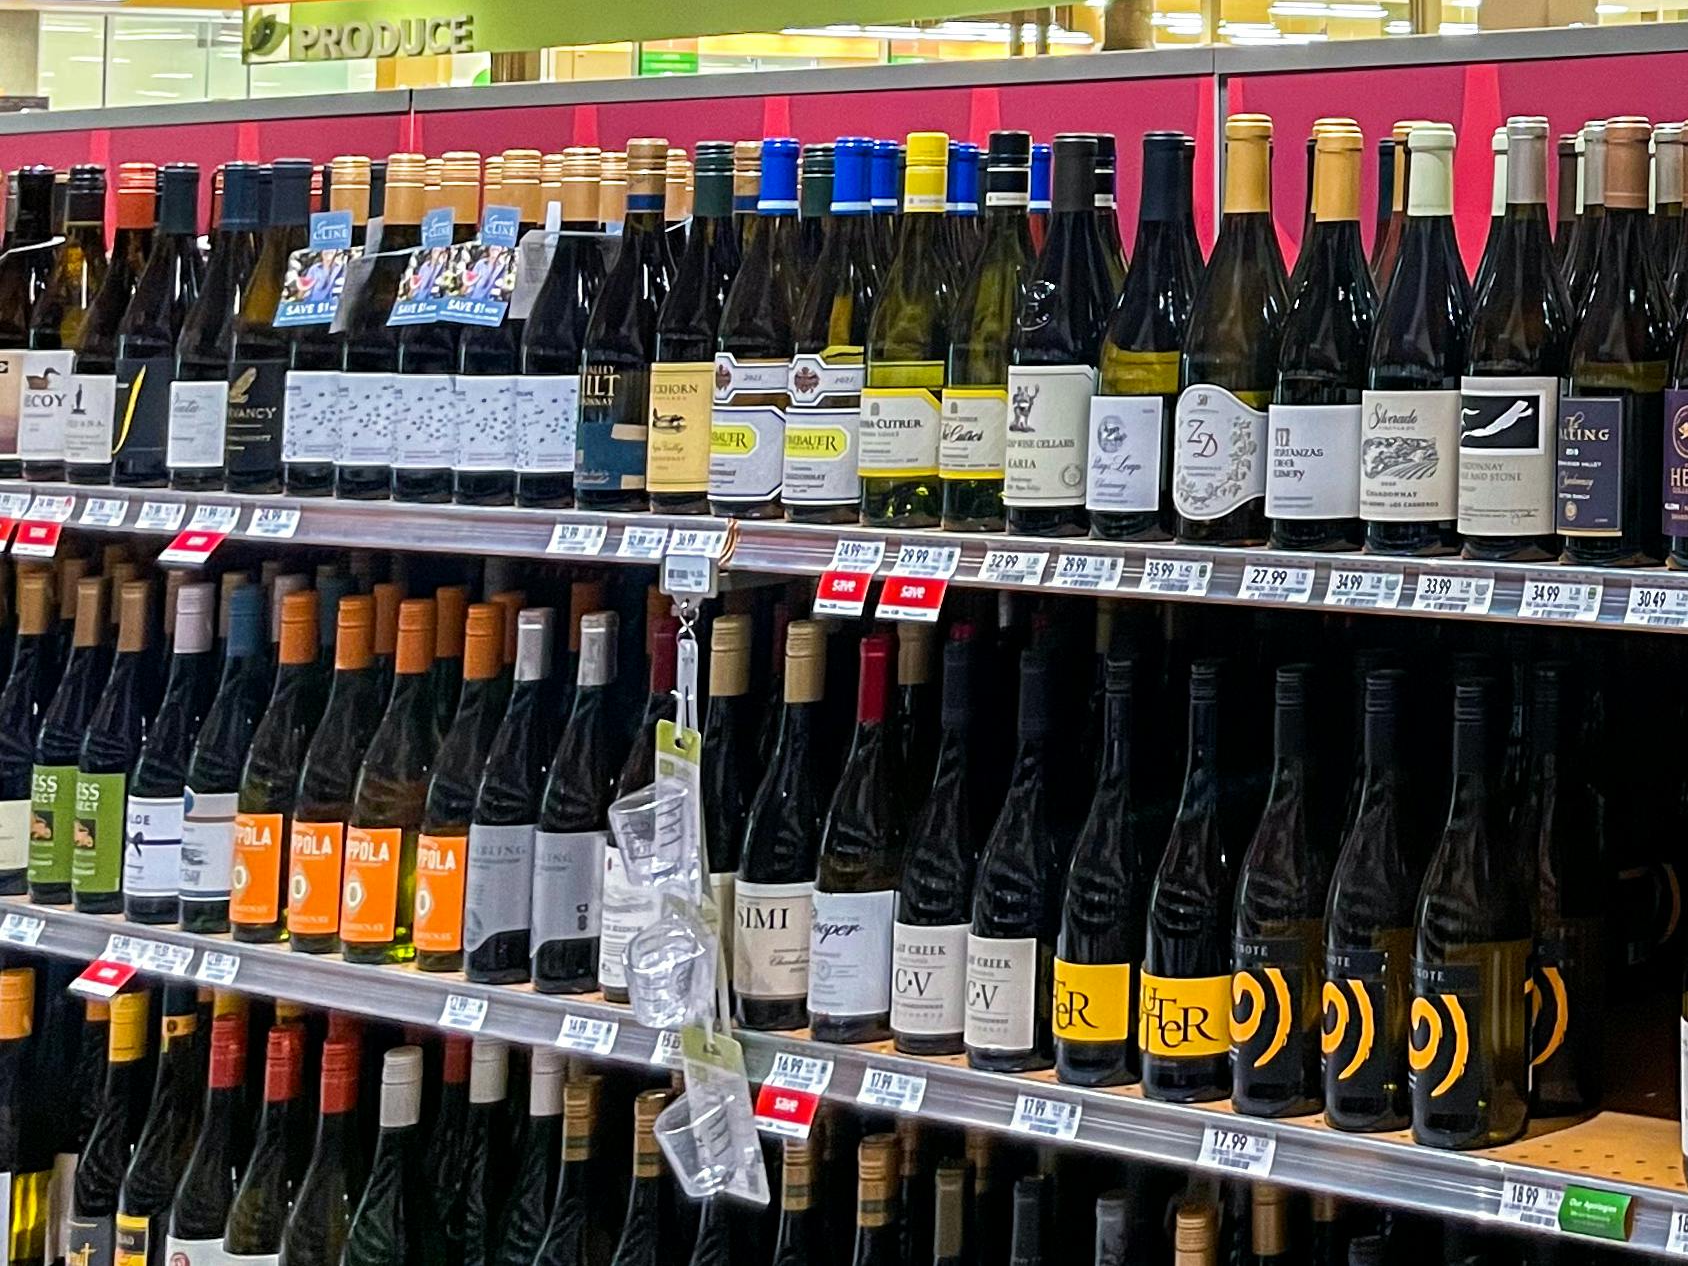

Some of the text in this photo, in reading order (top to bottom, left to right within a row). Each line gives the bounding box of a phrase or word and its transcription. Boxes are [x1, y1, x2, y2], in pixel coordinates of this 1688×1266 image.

[296, 14, 474, 59] PRODUCE
[286, 302, 330, 316] SAVE $1
[399, 302, 416, 315] SAVE
[447, 299, 485, 315] SAVE $1
[24, 393, 67, 408] ECOY
[1368, 402, 1418, 430] Silverado
[1036, 438, 1075, 449] CELLARS
[1251, 569, 1288, 585] 27.99
[832, 579, 857, 593] save
[900, 585, 927, 600] save
[33, 774, 58, 793] ESS
[77, 781, 100, 801] ESS
[130, 814, 151, 825] LOE
[738, 908, 790, 930] SIMI
[908, 945, 946, 956] CREEK
[977, 957, 1012, 969] CREEK
[777, 1057, 803, 1074] 16.99
[774, 1095, 798, 1114] save
[1023, 1099, 1047, 1116] 17.99
[1213, 1130, 1248, 1151] 17.99
[1511, 1184, 1540, 1206] 18.99
